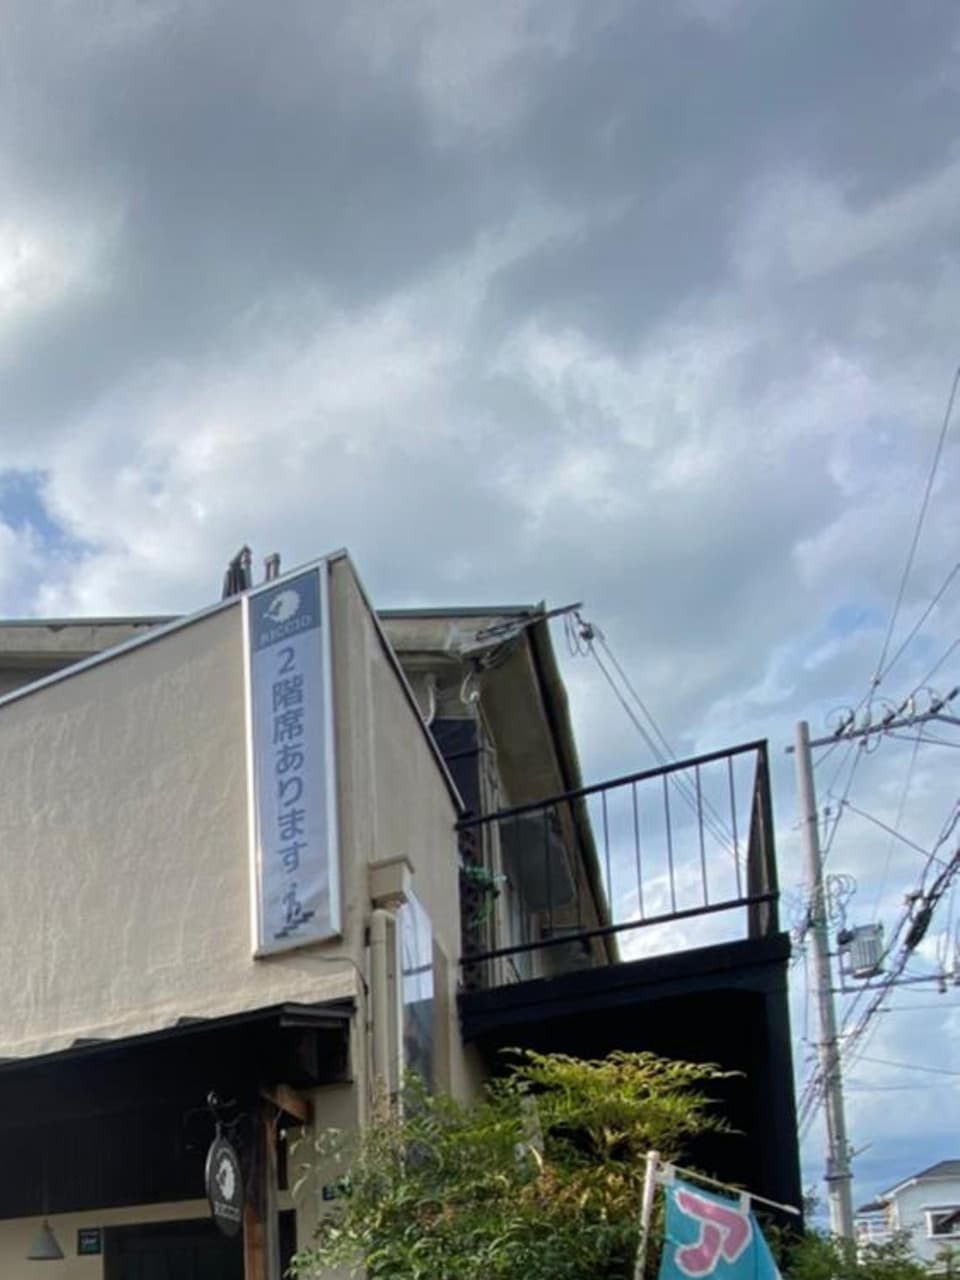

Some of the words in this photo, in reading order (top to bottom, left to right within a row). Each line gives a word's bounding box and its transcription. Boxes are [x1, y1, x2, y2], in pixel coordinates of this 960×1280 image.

[271, 647, 308, 876] 2階席あります
